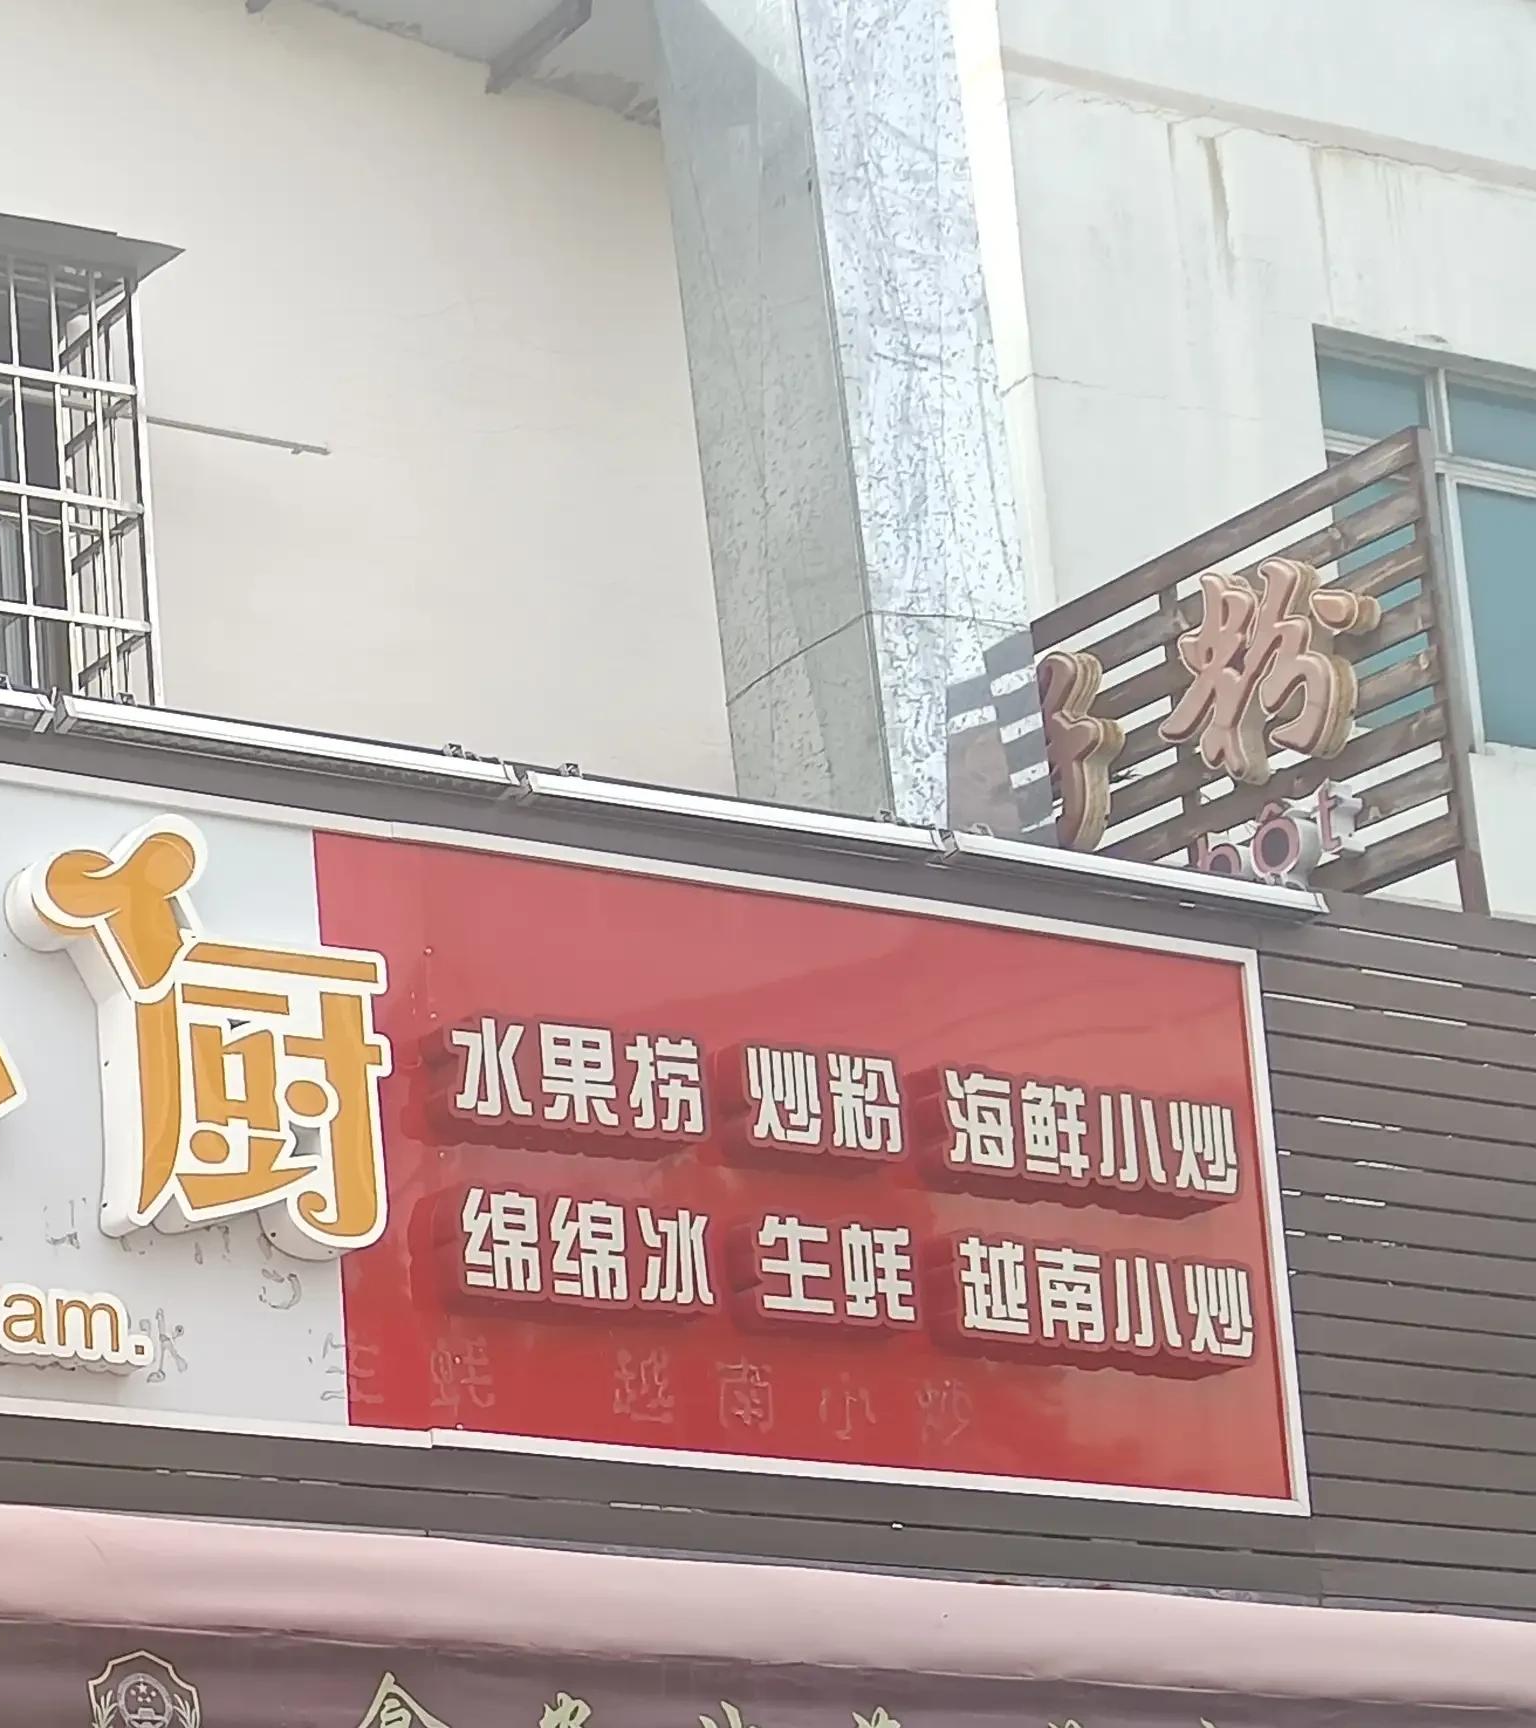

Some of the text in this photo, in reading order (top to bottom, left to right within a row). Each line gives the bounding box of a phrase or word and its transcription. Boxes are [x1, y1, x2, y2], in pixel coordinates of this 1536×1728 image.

[450, 1015, 1239, 1196] 水果捞 炒粉 海鲜小炒
[462, 1187, 1256, 1360] 绵绵冰 生蚝 越南小炒
